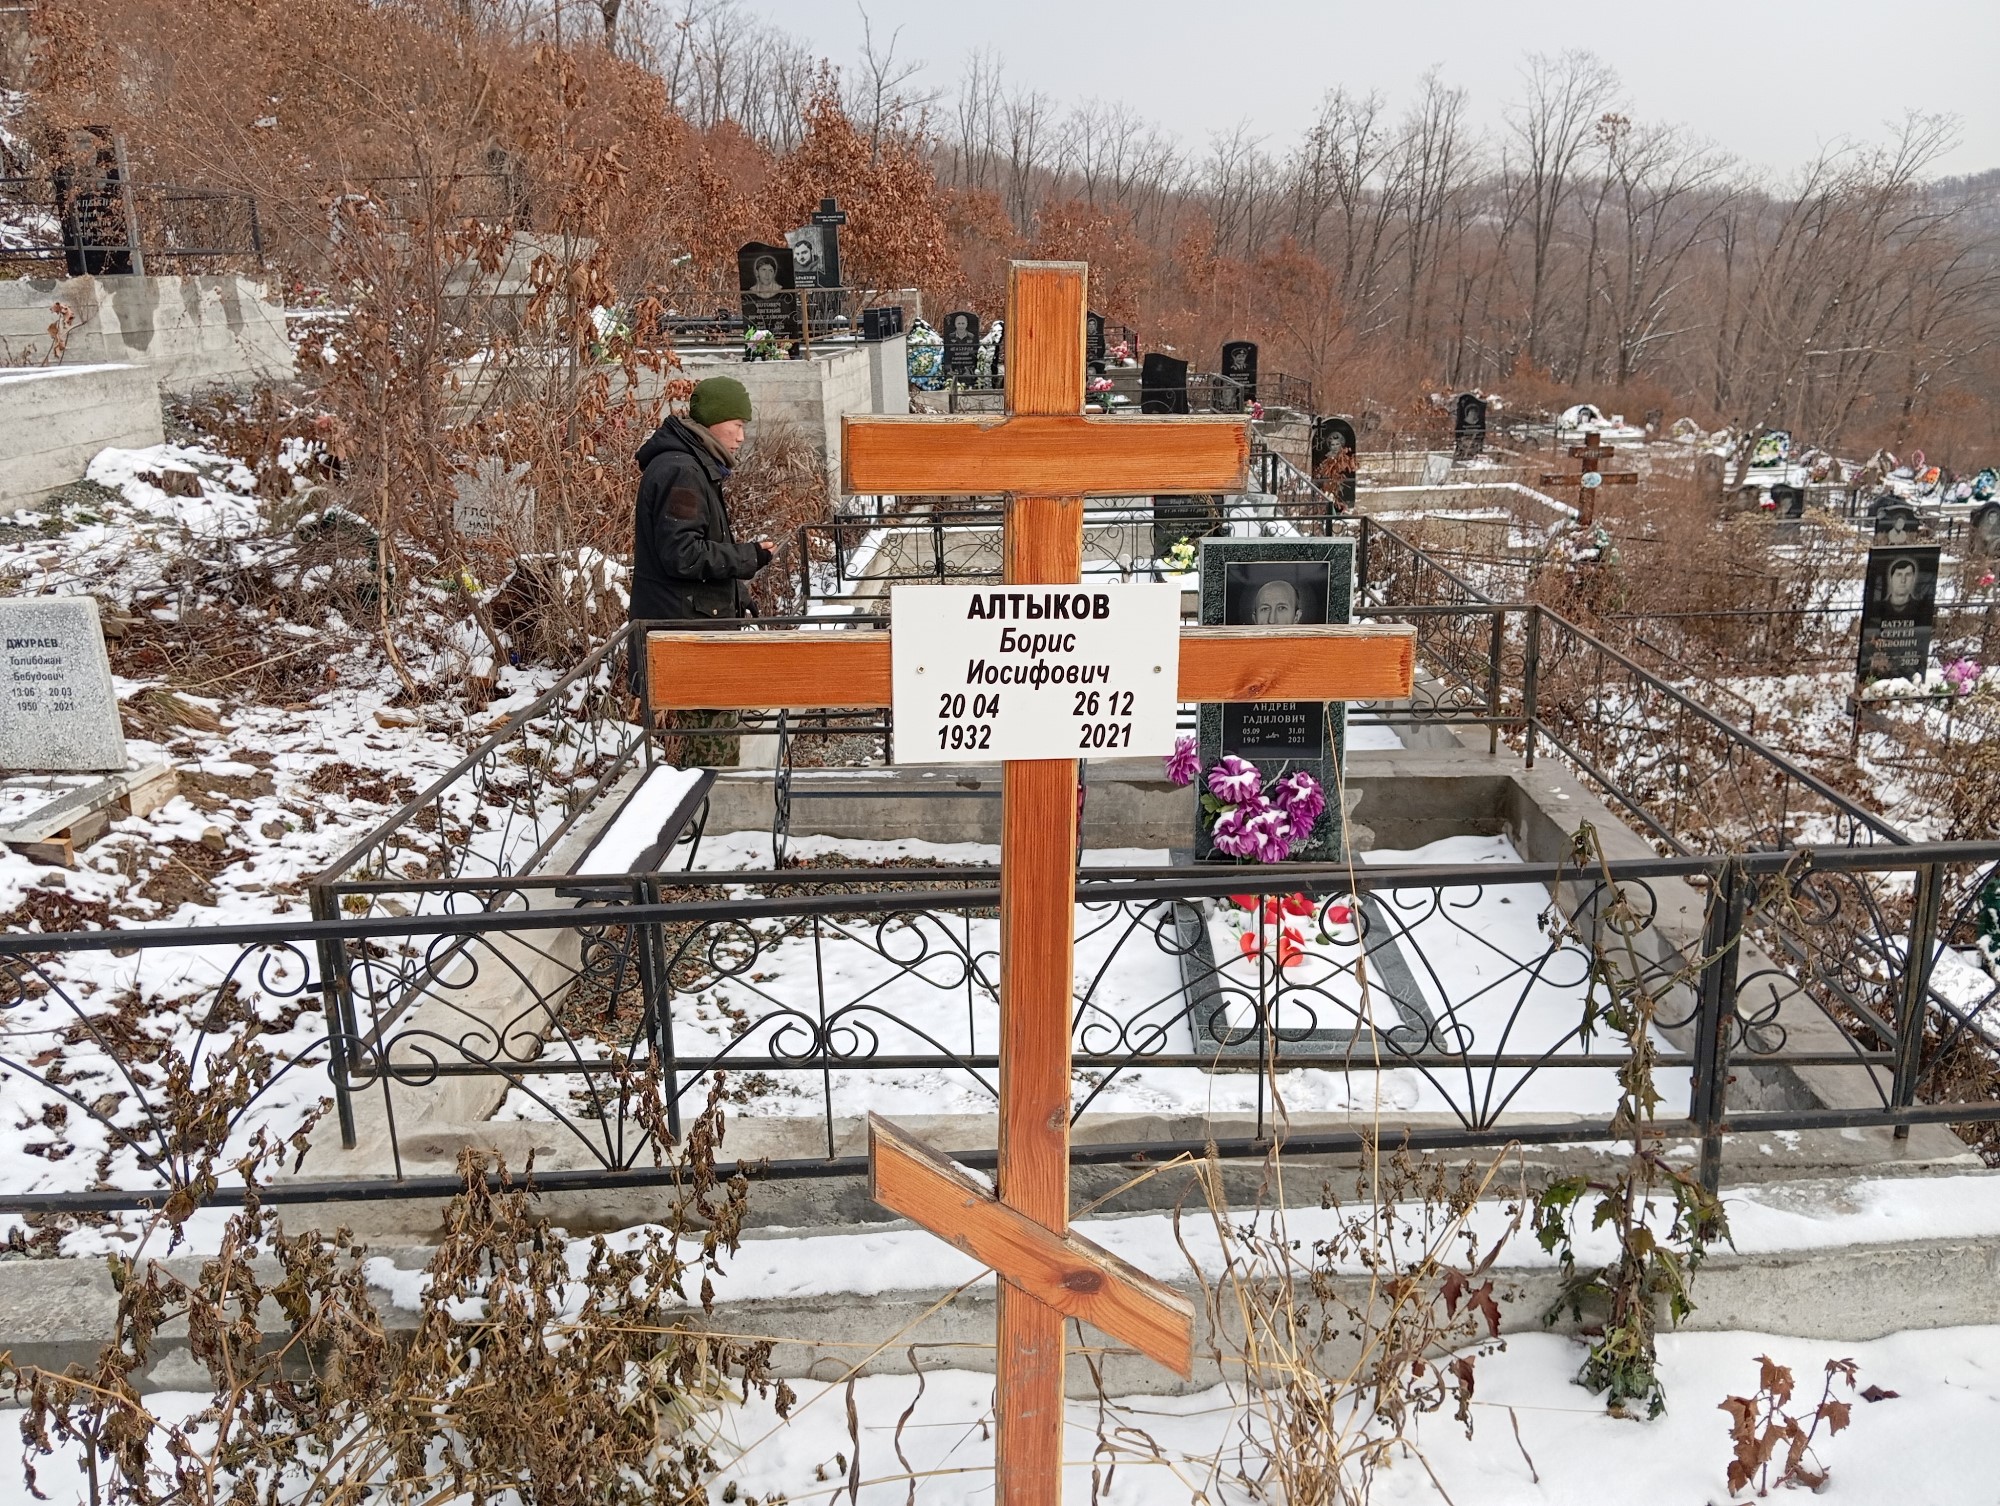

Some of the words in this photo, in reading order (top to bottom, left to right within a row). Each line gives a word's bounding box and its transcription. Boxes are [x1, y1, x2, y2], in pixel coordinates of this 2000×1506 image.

[967, 593, 1110, 620] АЛТЫКОВ
[6, 638, 58, 649] ДЖУРАЕВ
[999, 627, 1076, 659] Борис
[9, 655, 62, 666] Толибджан
[13, 671, 64, 682] Бебудович
[966, 658, 1110, 690] Иосифович
[17, 701, 38, 711] 1950
[54, 701, 74, 712] 2021
[938, 693, 966, 719] 20
[972, 693, 1000, 719] 04
[1072, 691, 1100, 716] 26
[1108, 690, 1135, 716] 12
[1242, 714, 1306, 724] ГАДИЛОВИЧ
[937, 725, 992, 750] 1932
[1079, 722, 1132, 748] 2021
[1242, 727, 1261, 735] 05.09
[1288, 727, 1305, 735] 31.01
